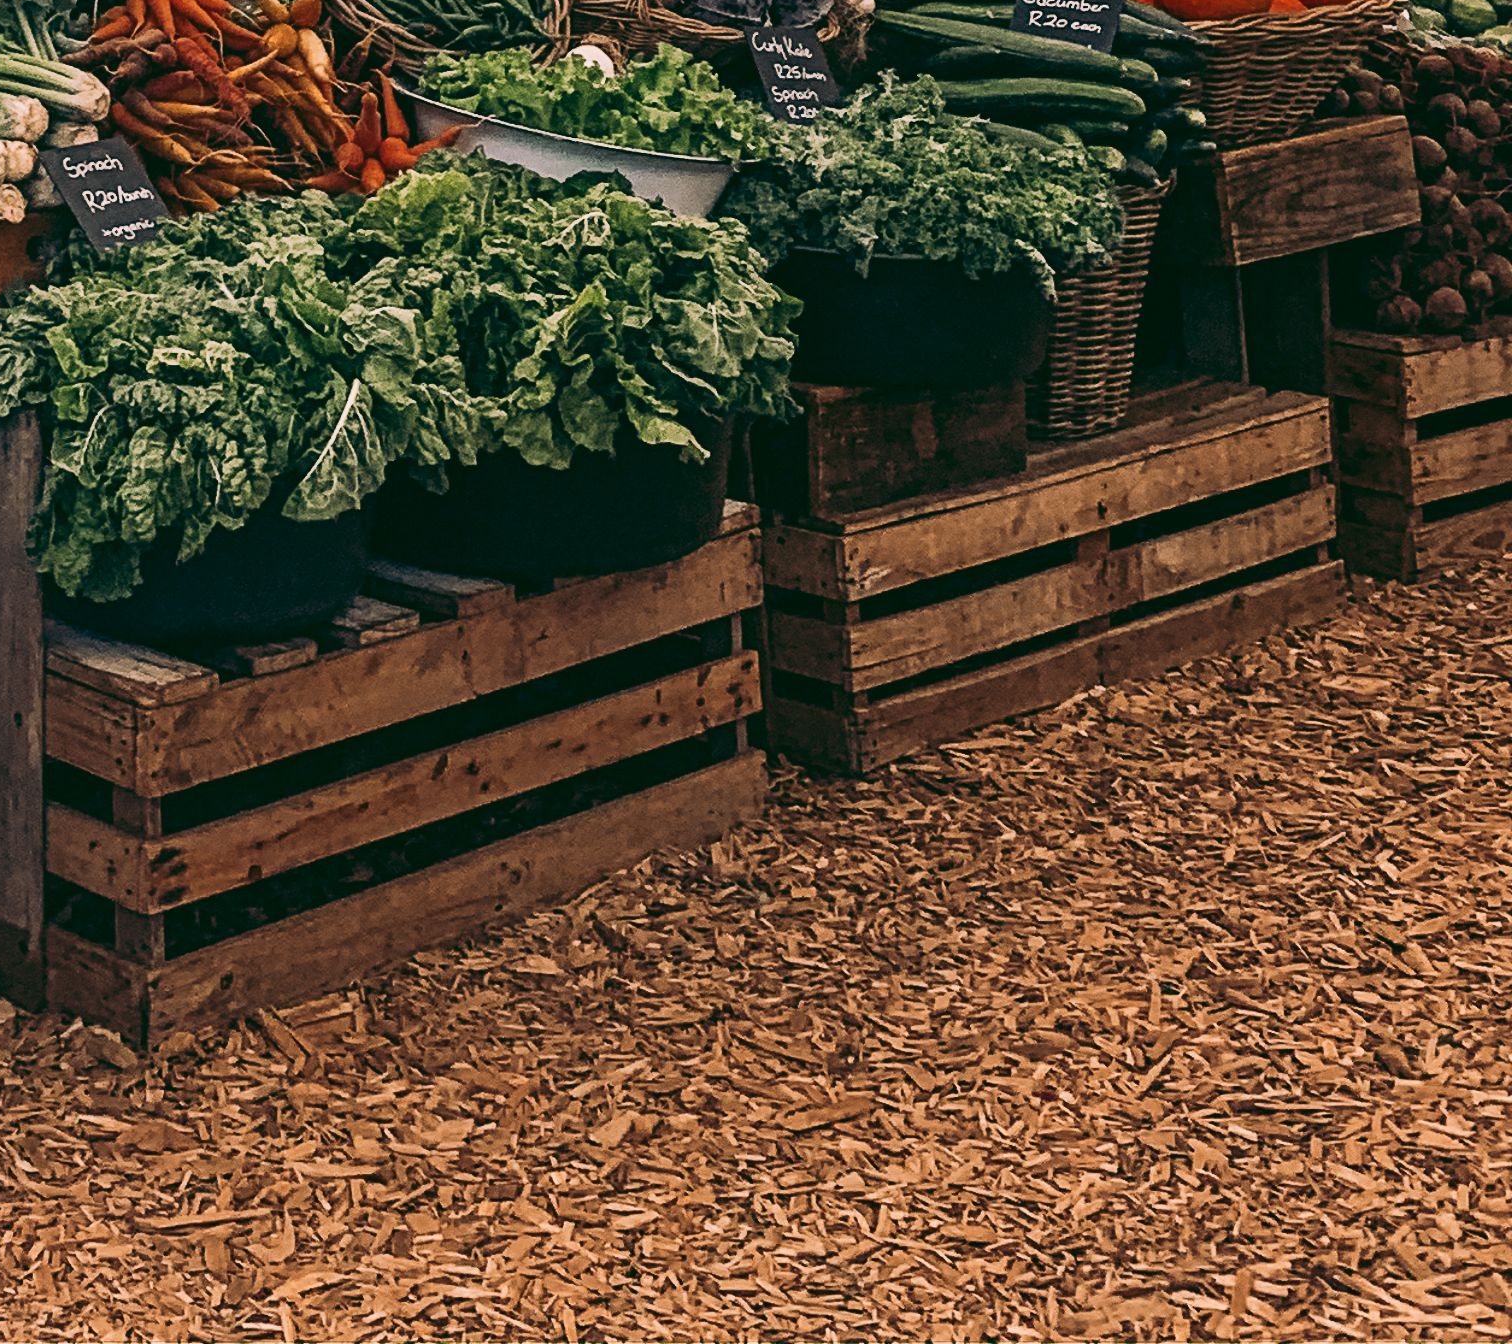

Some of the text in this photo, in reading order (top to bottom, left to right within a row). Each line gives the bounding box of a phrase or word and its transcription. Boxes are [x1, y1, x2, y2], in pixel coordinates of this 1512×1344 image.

[1028, 10, 1068, 28] R20
[751, 31, 813, 61] Curly Kale
[62, 154, 124, 179] Spinach
[81, 185, 155, 214] R20/bunch
